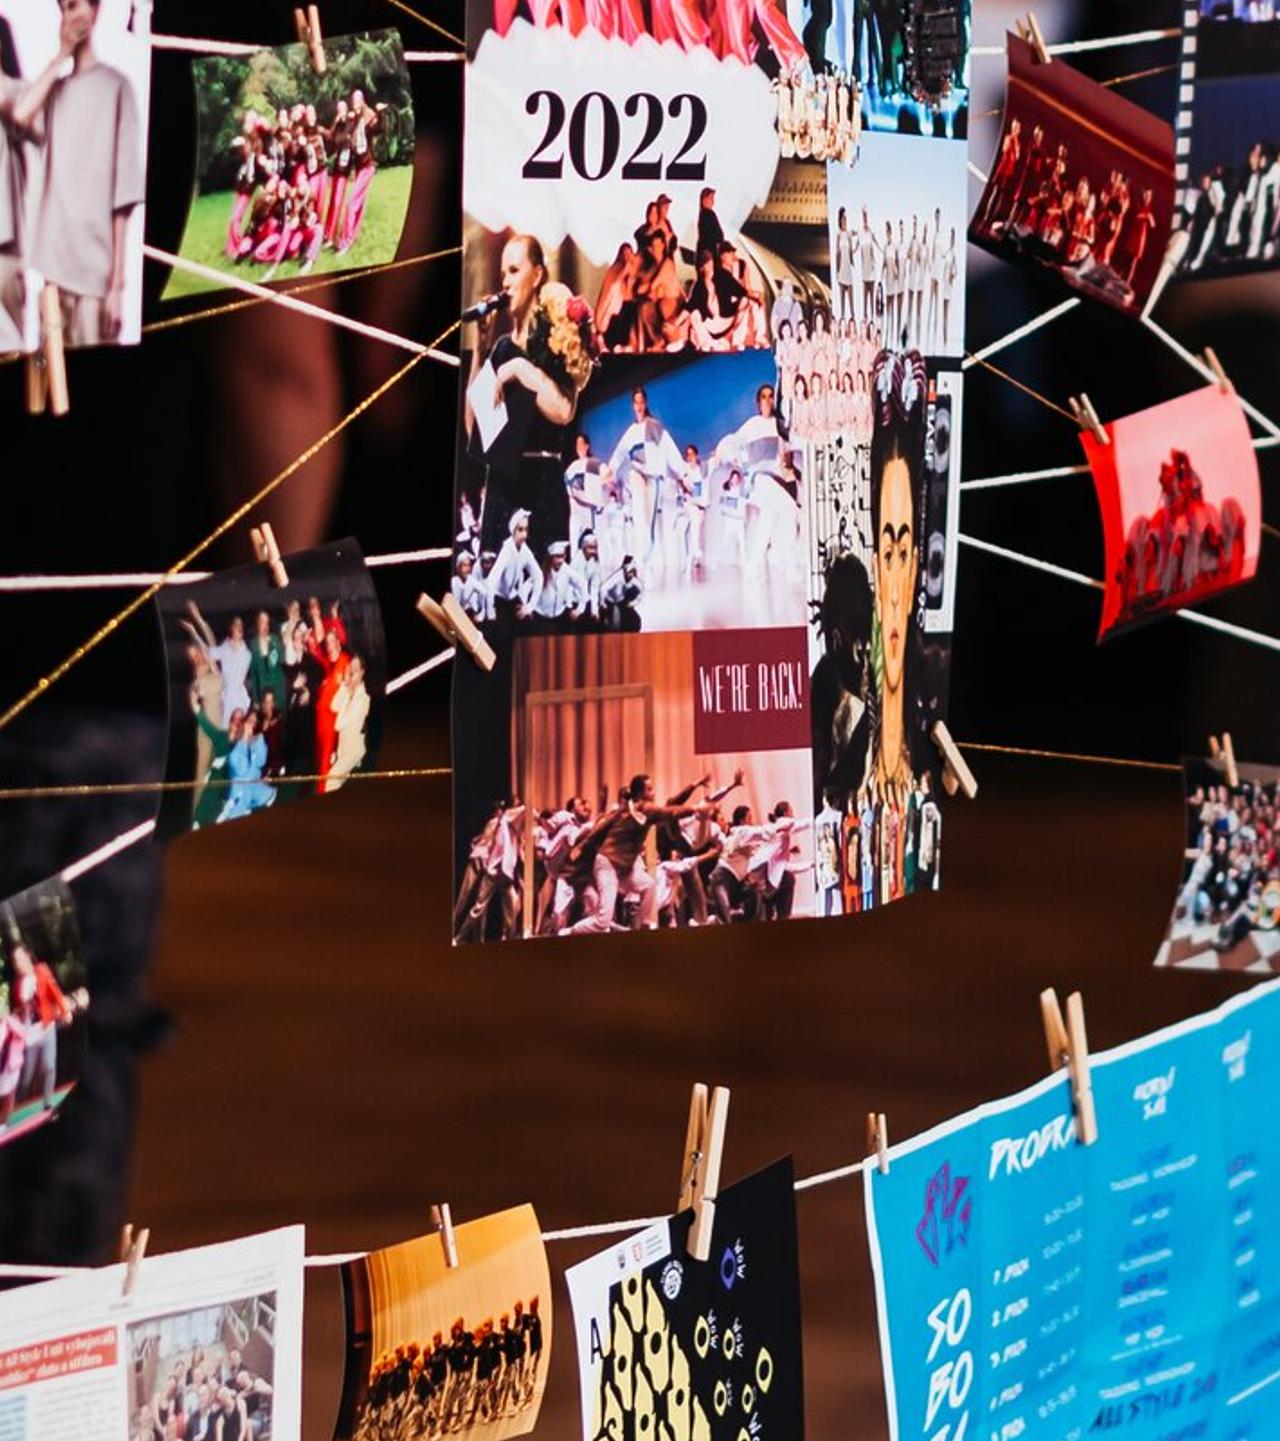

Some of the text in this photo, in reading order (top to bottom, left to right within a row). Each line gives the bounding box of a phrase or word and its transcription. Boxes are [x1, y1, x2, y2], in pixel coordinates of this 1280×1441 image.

[521, 90, 709, 181] 2022
[699, 660, 803, 715] WE'RE BACK!
[926, 1287, 972, 1364] SO
[923, 1350, 973, 1432] BO
